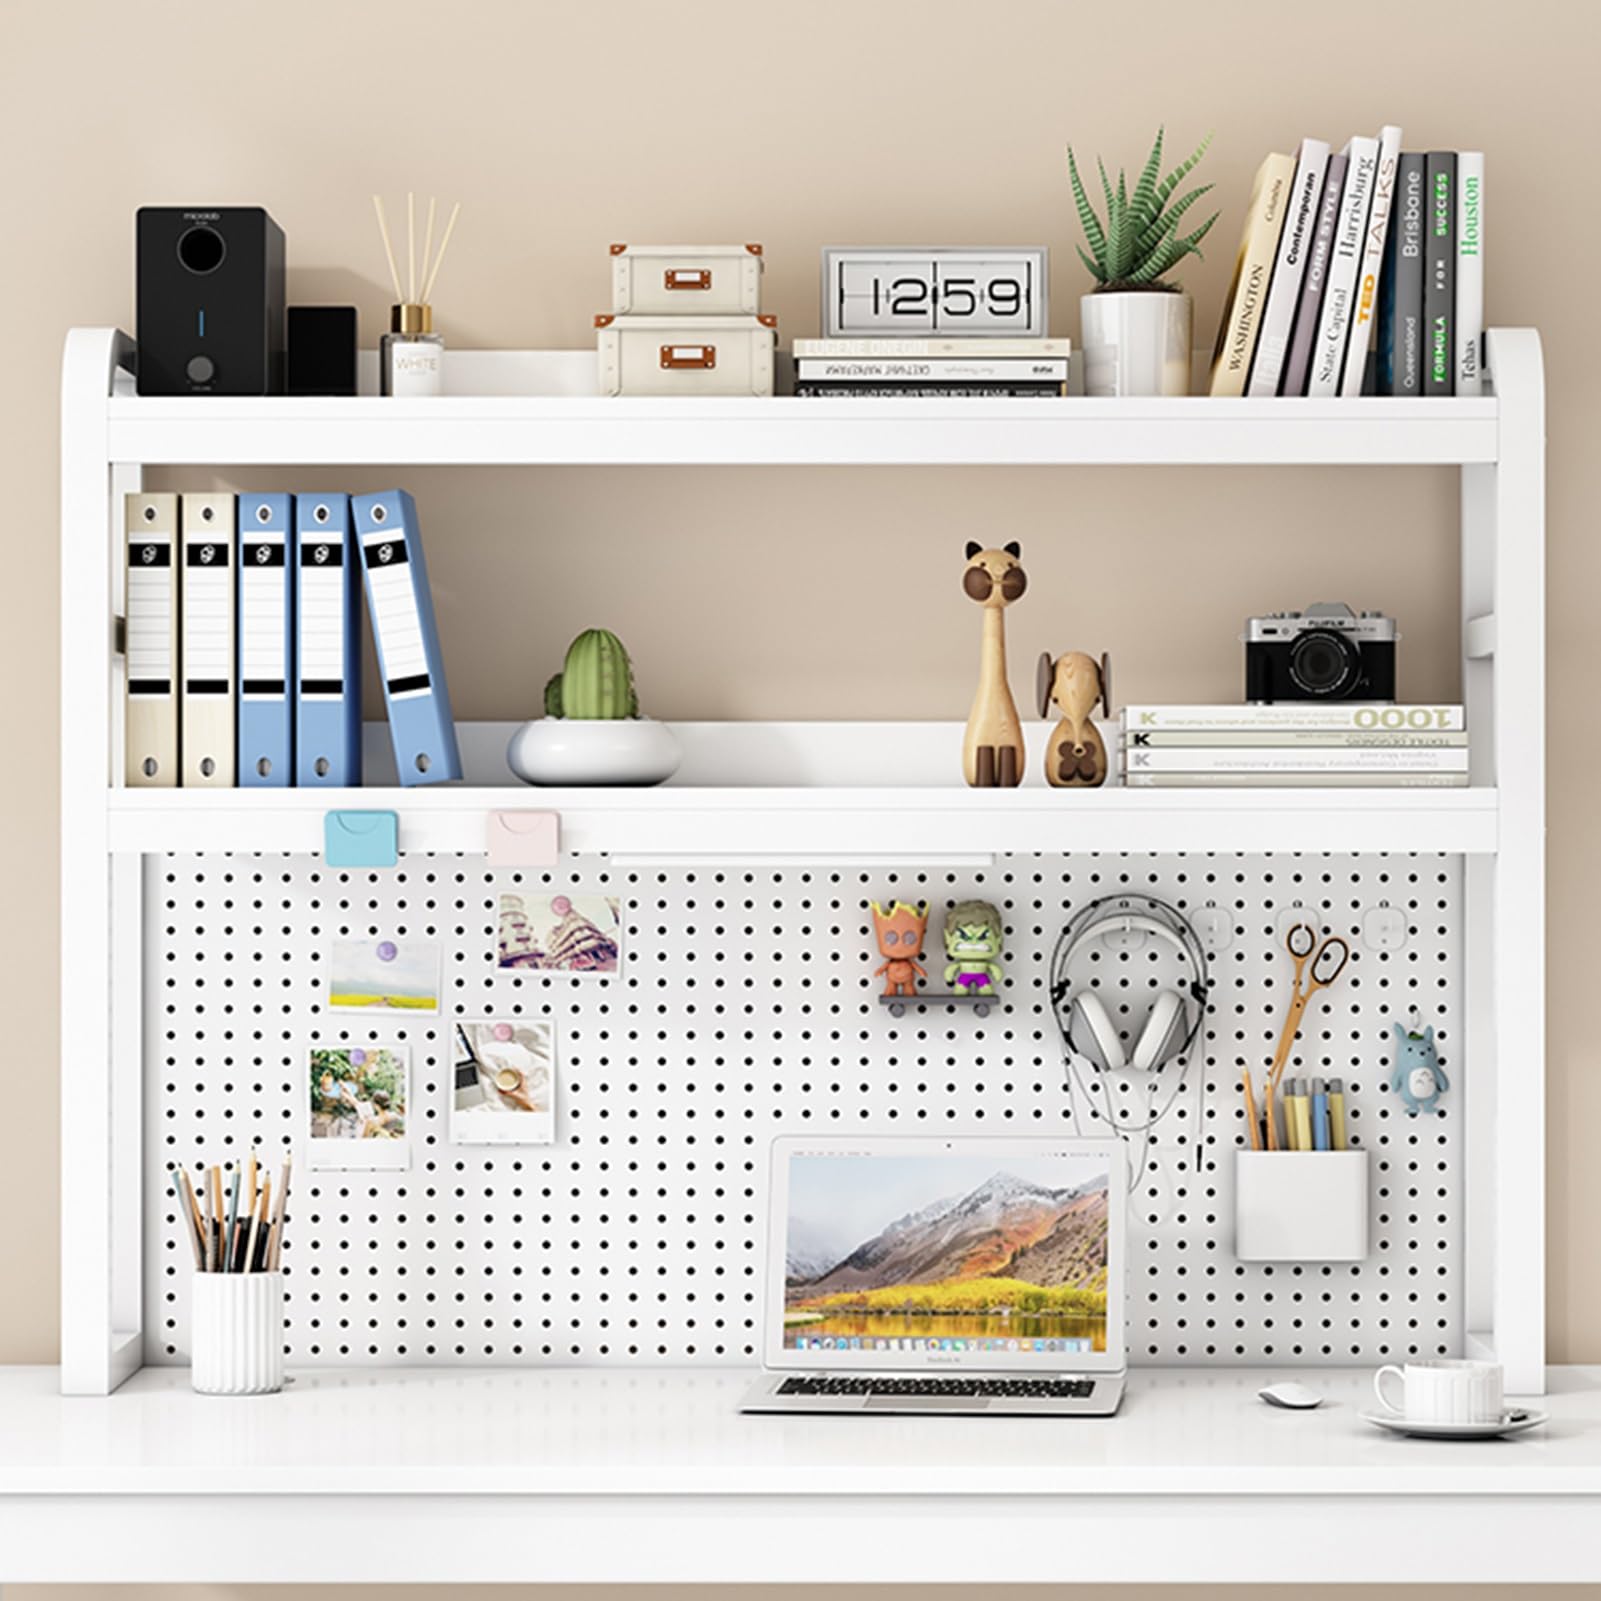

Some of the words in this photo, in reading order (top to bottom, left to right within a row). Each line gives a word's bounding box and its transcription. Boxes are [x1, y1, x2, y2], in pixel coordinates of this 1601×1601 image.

[1286, 172, 1316, 266] Contemporan
[1308, 240, 1329, 292] FORM
[1320, 180, 1340, 234] STYLE
[1338, 156, 1374, 258] Harrisburg
[1402, 171, 1421, 257] Brisbane
[1435, 173, 1448, 237] SUCCESS
[1461, 177, 1479, 257] Houston
[1357, 274, 1376, 325] TED
[1367, 158, 1395, 259] TALKS
[1435, 260, 1445, 290] FOR
[1229, 264, 1263, 371] WASHINGTON
[1326, 288, 1347, 342] Capital
[396, 357, 437, 370] WHITE
[1319, 344, 1337, 383] State
[1433, 316, 1446, 383] FORMULA
[1133, 733, 1151, 746] K
[1353, 708, 1452, 730] 1000
[1133, 753, 1150, 766] K
